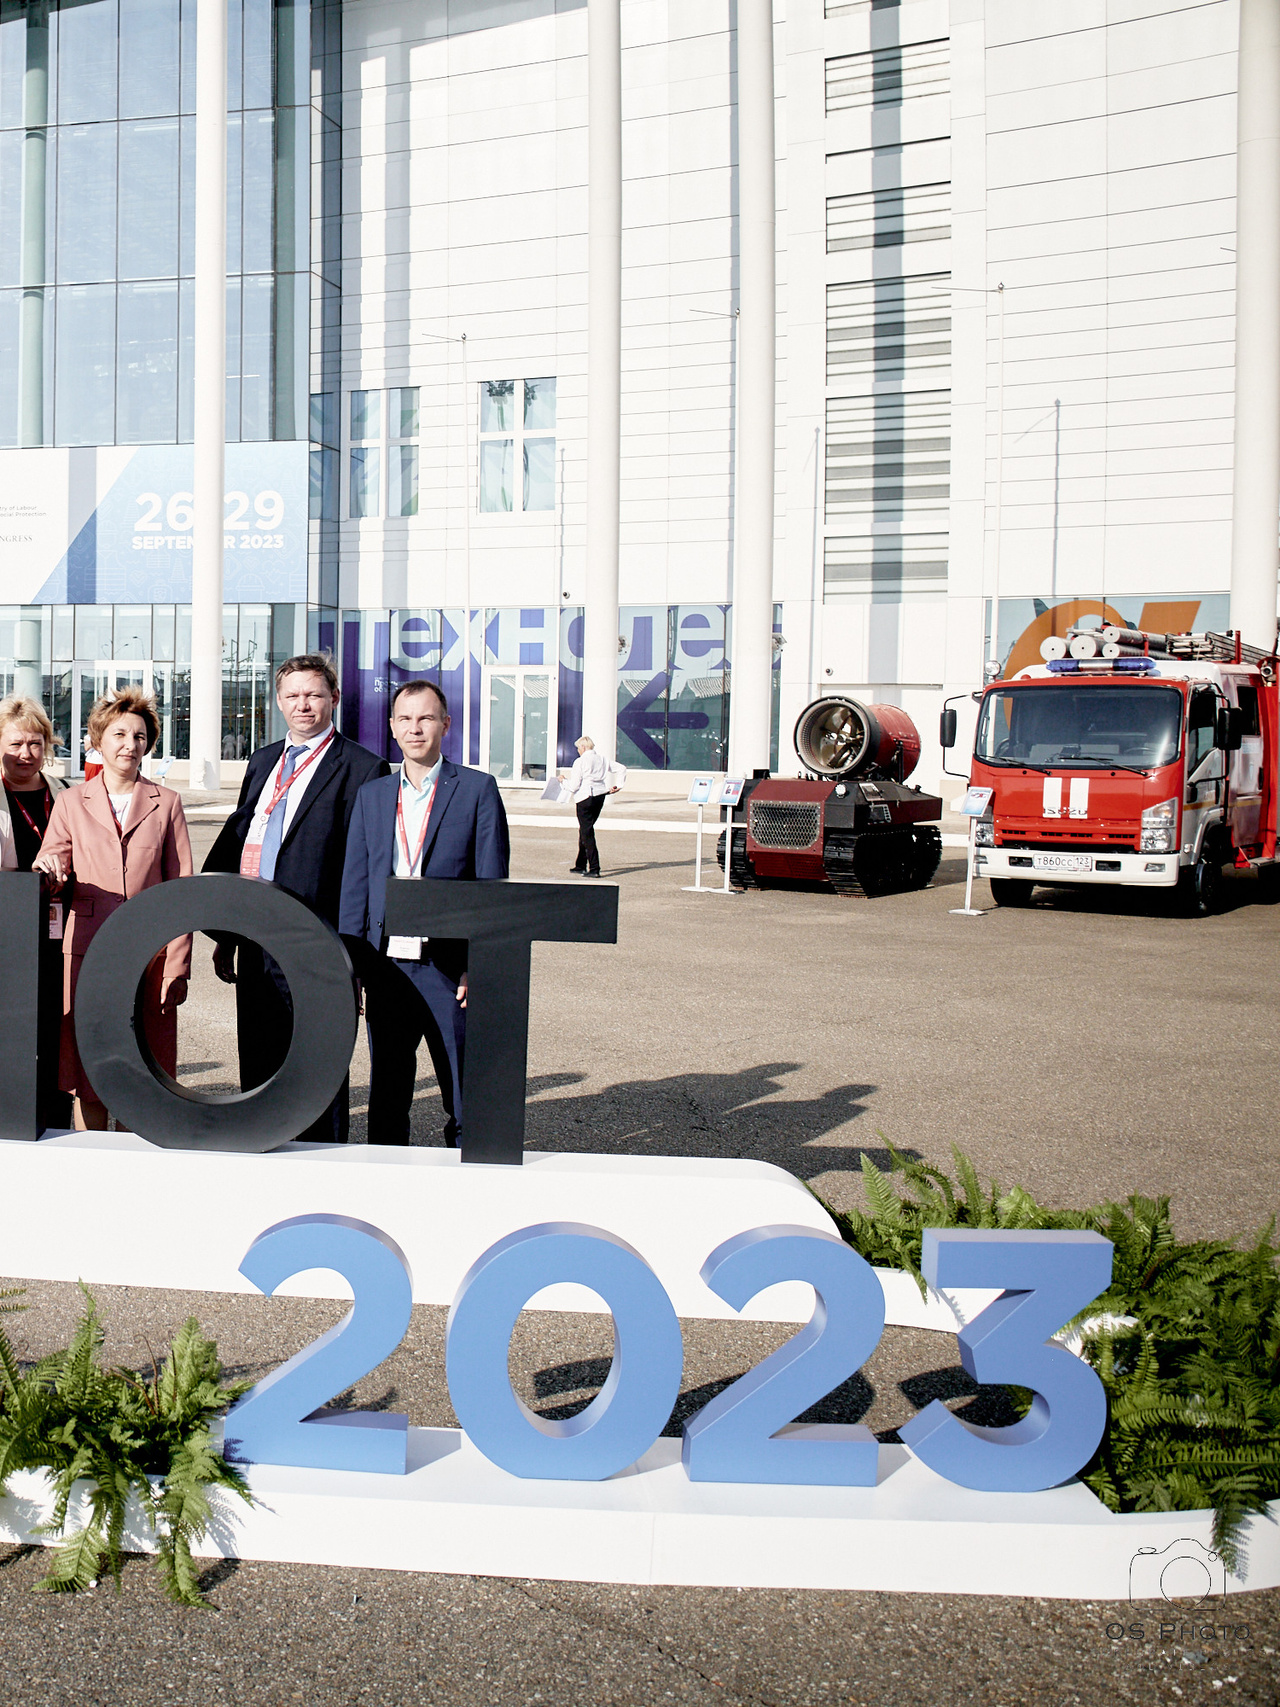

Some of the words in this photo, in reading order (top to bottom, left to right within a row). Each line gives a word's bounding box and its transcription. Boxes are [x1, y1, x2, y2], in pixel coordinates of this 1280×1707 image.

[134, 490, 284, 531] 2629
[239, 534, 284, 549] 2023
[220, 1213, 1115, 1494] 2023
